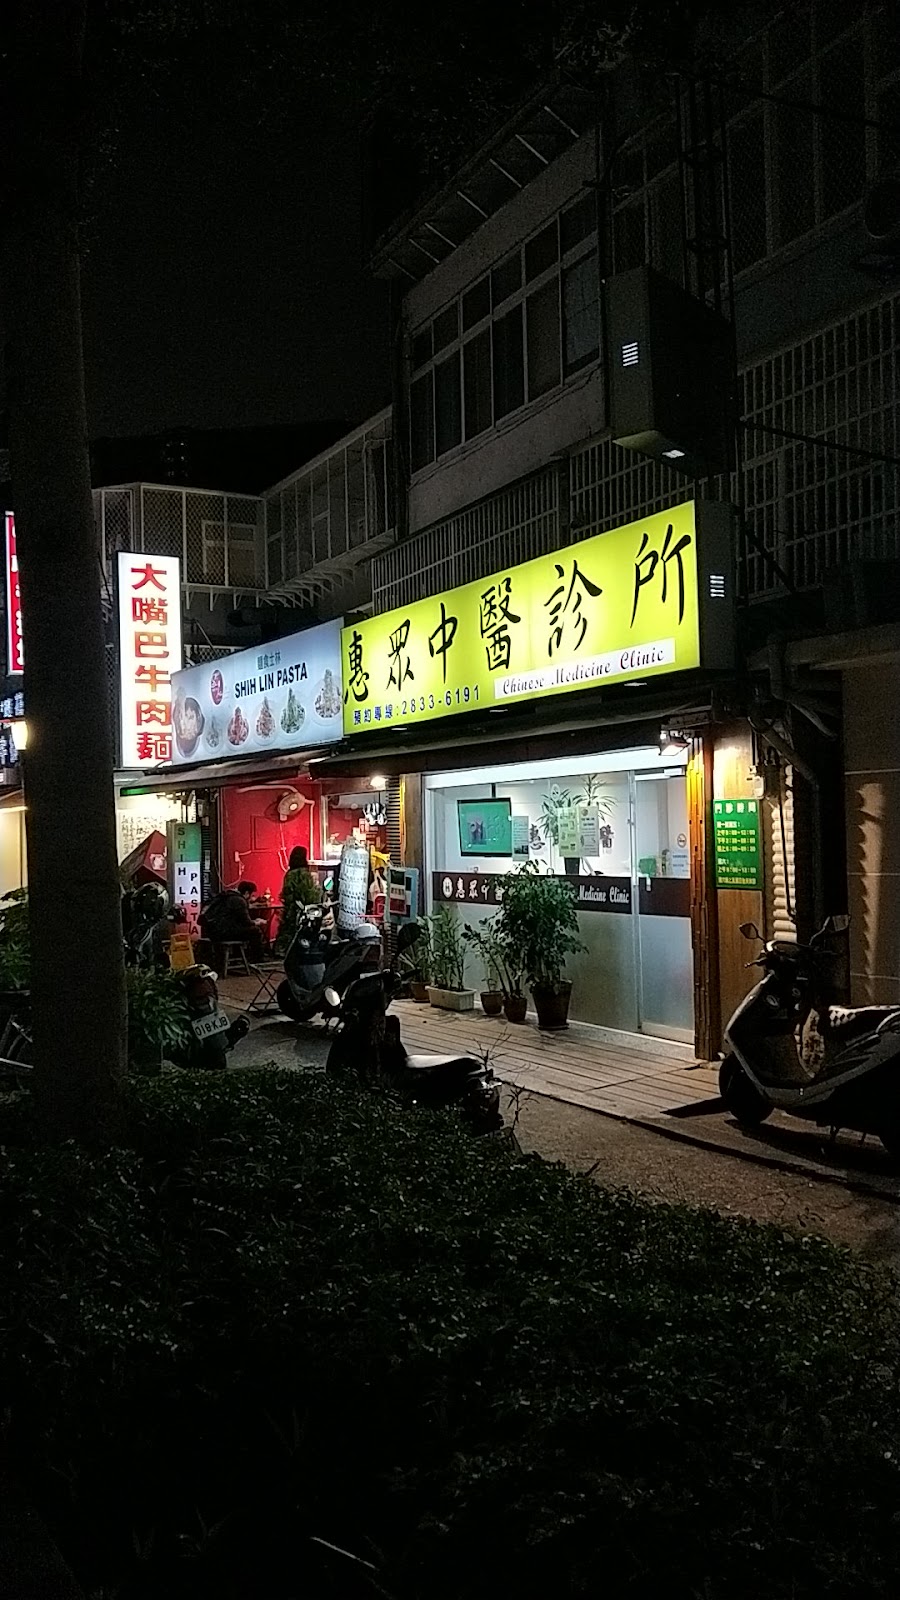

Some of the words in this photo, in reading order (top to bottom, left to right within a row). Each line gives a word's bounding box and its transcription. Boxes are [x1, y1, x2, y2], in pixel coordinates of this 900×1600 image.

[344, 523, 692, 705] 惠眾中醫診所
[131, 563, 172, 760] 大嘴巴牛肉麵
[234, 677, 257, 698] SHIH
[259, 672, 275, 692] LIN
[277, 662, 308, 687] PASTA
[502, 676, 545, 695] Chinese
[551, 661, 612, 686] Medicine
[620, 647, 665, 670] Clinic
[190, 872, 199, 936] PASTA
[609, 886, 630, 904] Clinic
